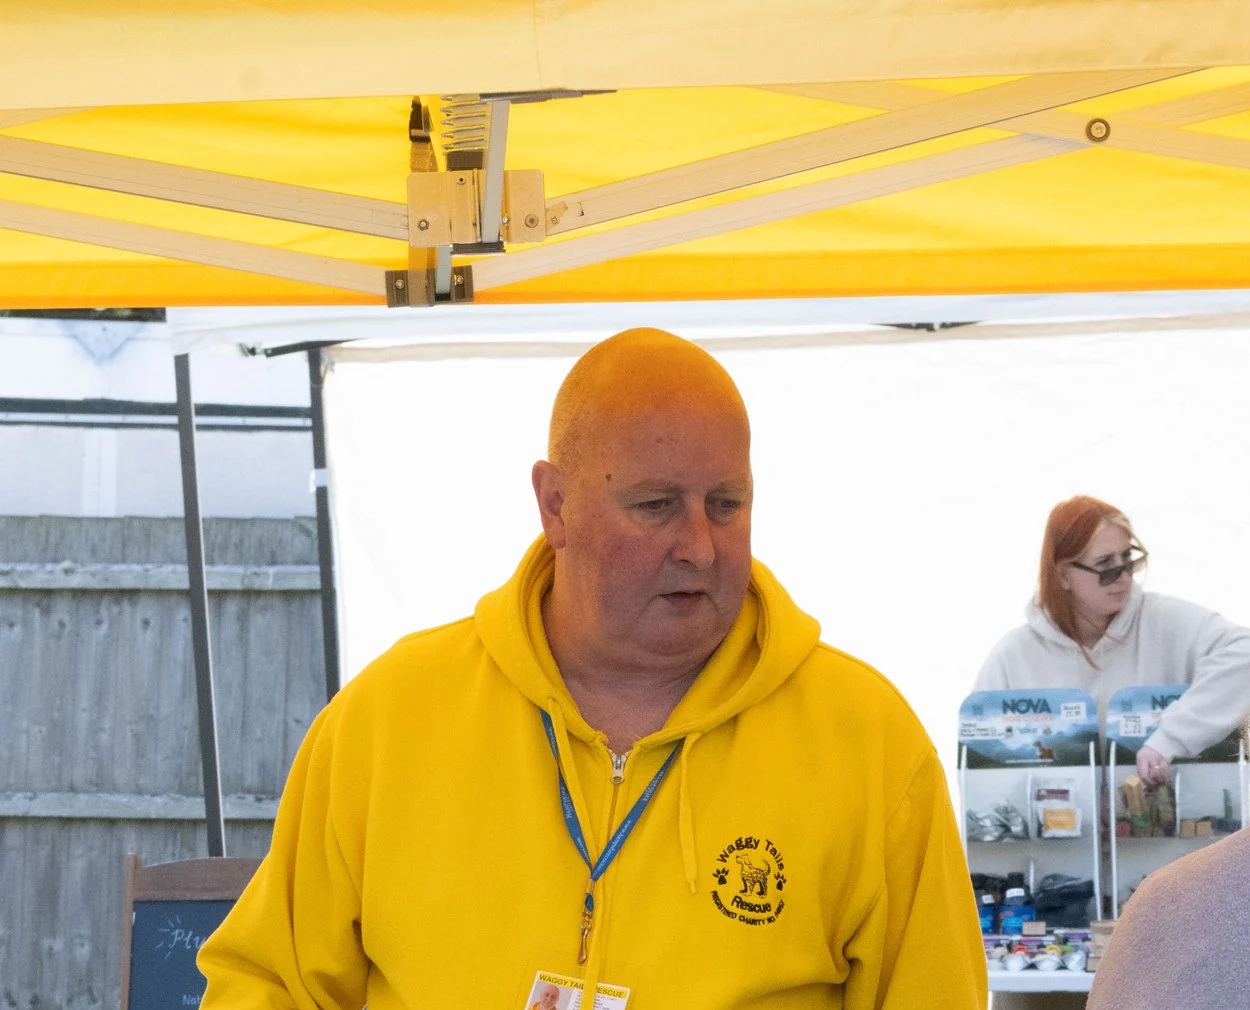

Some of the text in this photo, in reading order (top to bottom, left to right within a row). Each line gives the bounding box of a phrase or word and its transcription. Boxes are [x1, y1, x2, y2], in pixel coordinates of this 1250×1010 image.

[1002, 698, 1052, 715] NOVA
[1152, 695, 1181, 711] NO
[716, 836, 784, 871] Waggy Tails
[710, 890, 737, 919] REGISTERED
[739, 915, 765, 926] CHARITY
[731, 895, 772, 913] Rescue
[539, 974, 568, 986] WAGGY
[570, 981, 585, 990] TAIL
